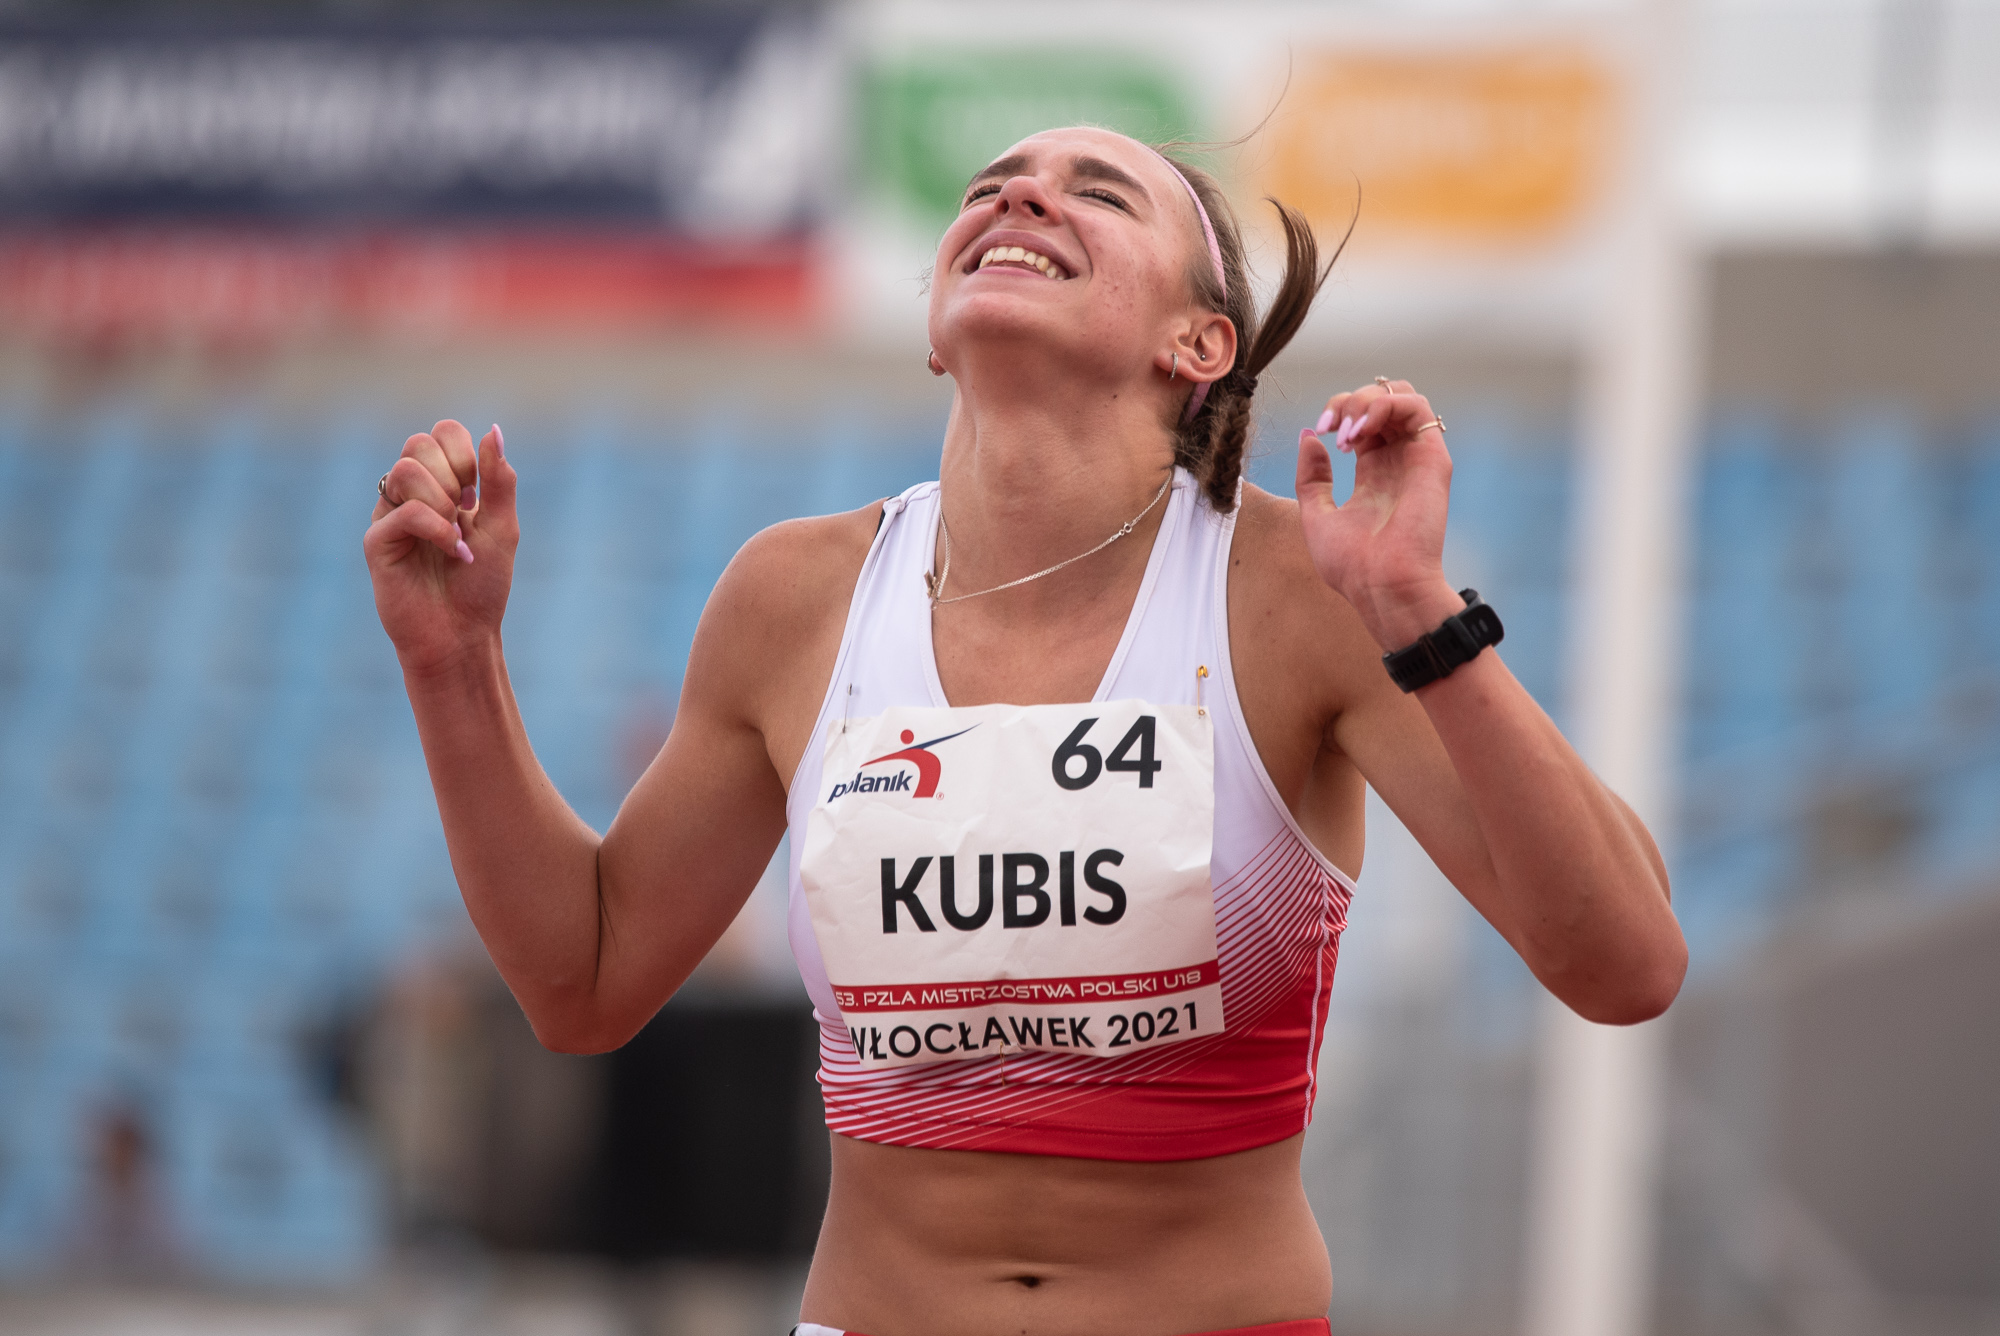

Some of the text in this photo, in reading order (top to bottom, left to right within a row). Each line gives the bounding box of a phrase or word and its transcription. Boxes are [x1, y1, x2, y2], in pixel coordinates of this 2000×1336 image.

[1052, 715, 1162, 791] 64
[881, 848, 1127, 934] KUBIS
[835, 970, 1202, 1006] 53. PZLA MISTRZOSTWA POLSKI U18
[1107, 1001, 1197, 1049] 2021
